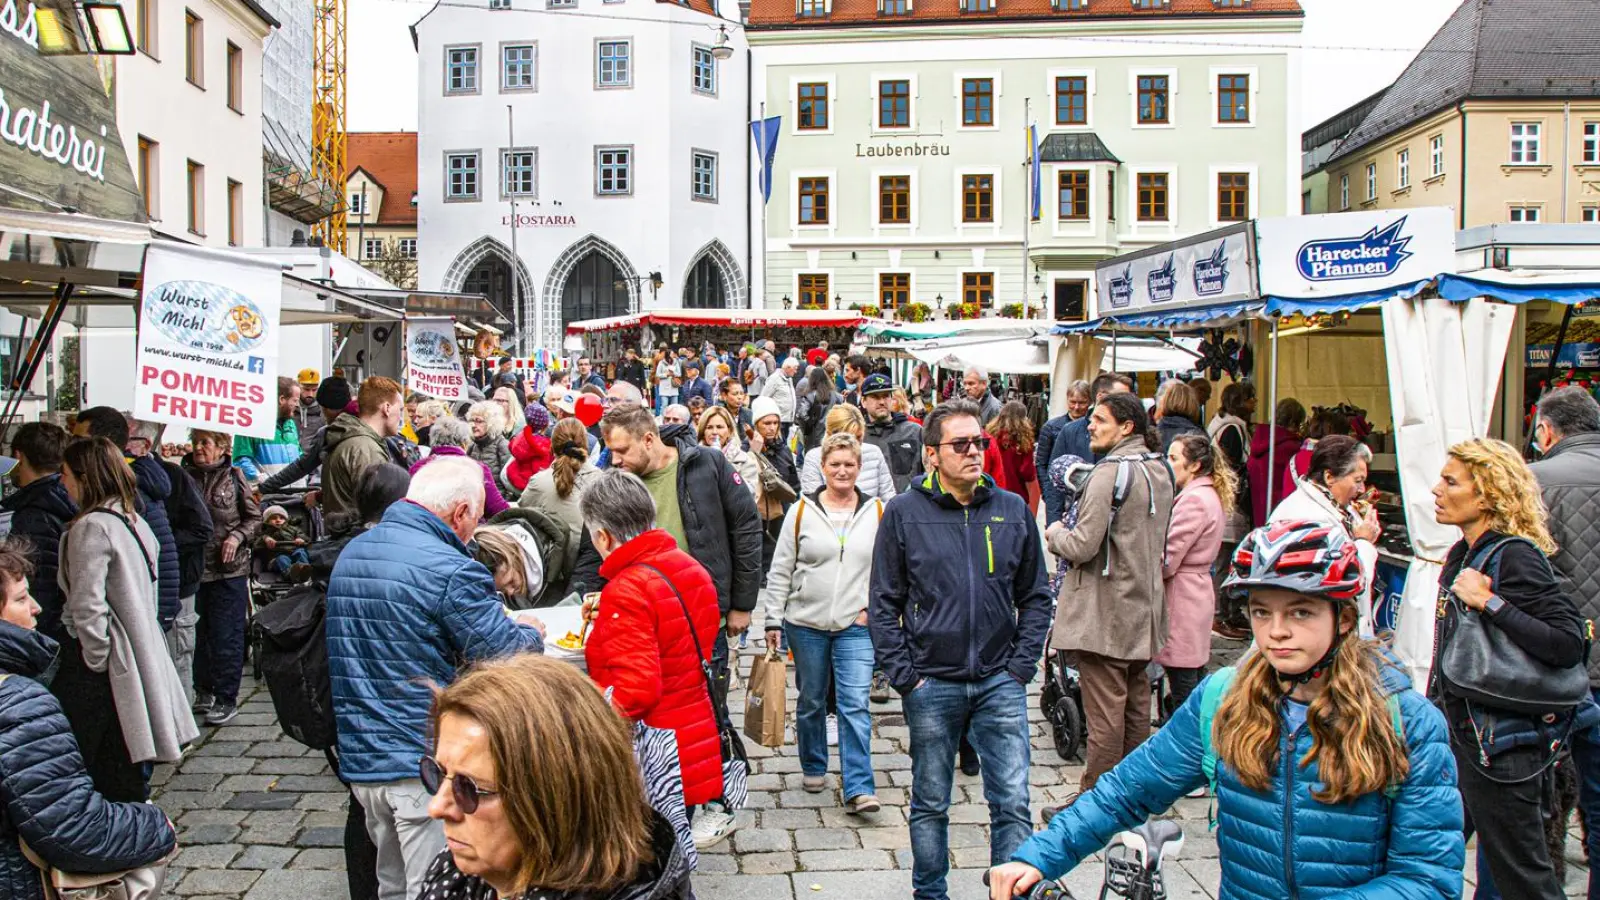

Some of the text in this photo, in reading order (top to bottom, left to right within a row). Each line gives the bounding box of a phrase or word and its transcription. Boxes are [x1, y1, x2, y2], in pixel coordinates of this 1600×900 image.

[856, 142, 950, 157] Laubenbräu
[1306, 243, 1390, 262] Harecker
[1312, 261, 1387, 277] Pfannen
[160, 288, 209, 310] Wurst
[161, 311, 205, 331] Michl
[141, 365, 265, 404] POMMES
[411, 368, 463, 386] POMMES
[416, 380, 459, 397] FRITES
[152, 393, 253, 427] FRITES
